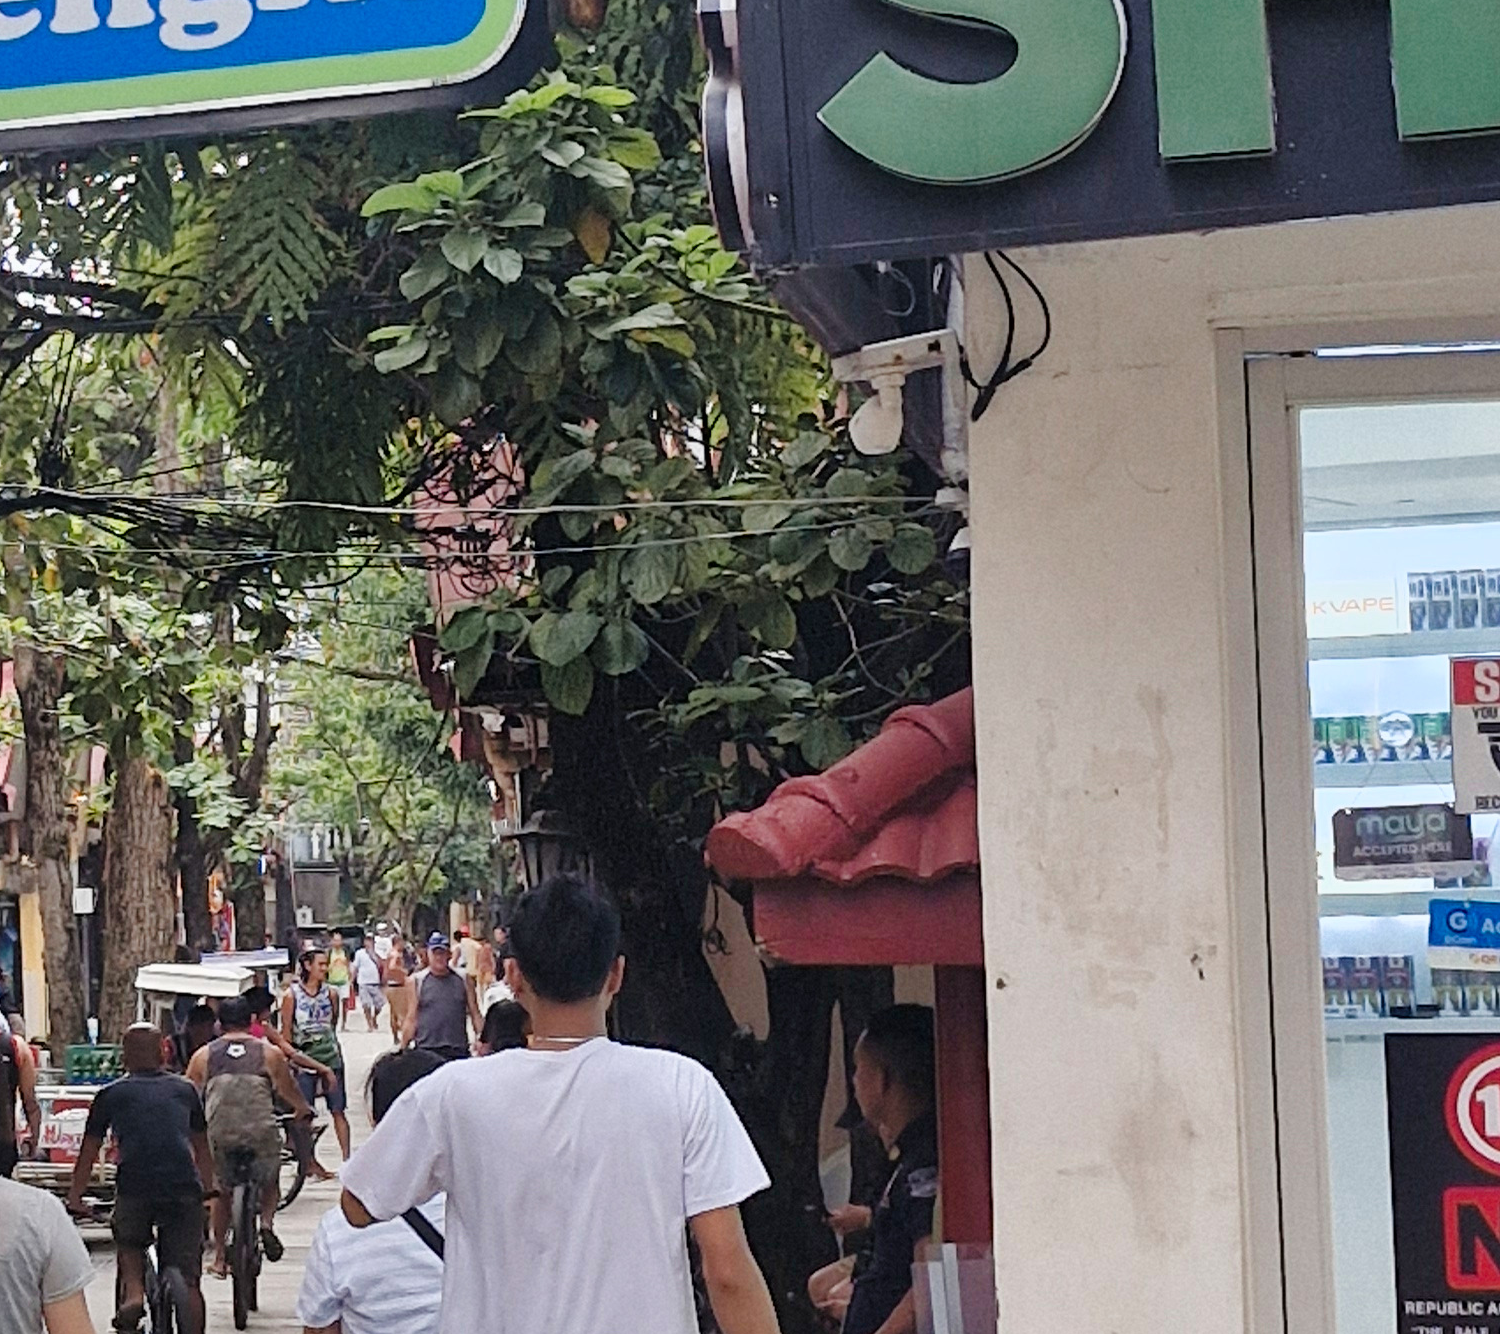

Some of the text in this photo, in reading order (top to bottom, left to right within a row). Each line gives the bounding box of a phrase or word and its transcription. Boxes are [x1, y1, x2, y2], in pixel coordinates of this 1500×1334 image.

[1472, 706, 1498, 719] YOU
[1356, 813, 1447, 839] maya
[1352, 843, 1418, 857] ACCEPTED
[1404, 1300, 1484, 1316] REPUBLIC
